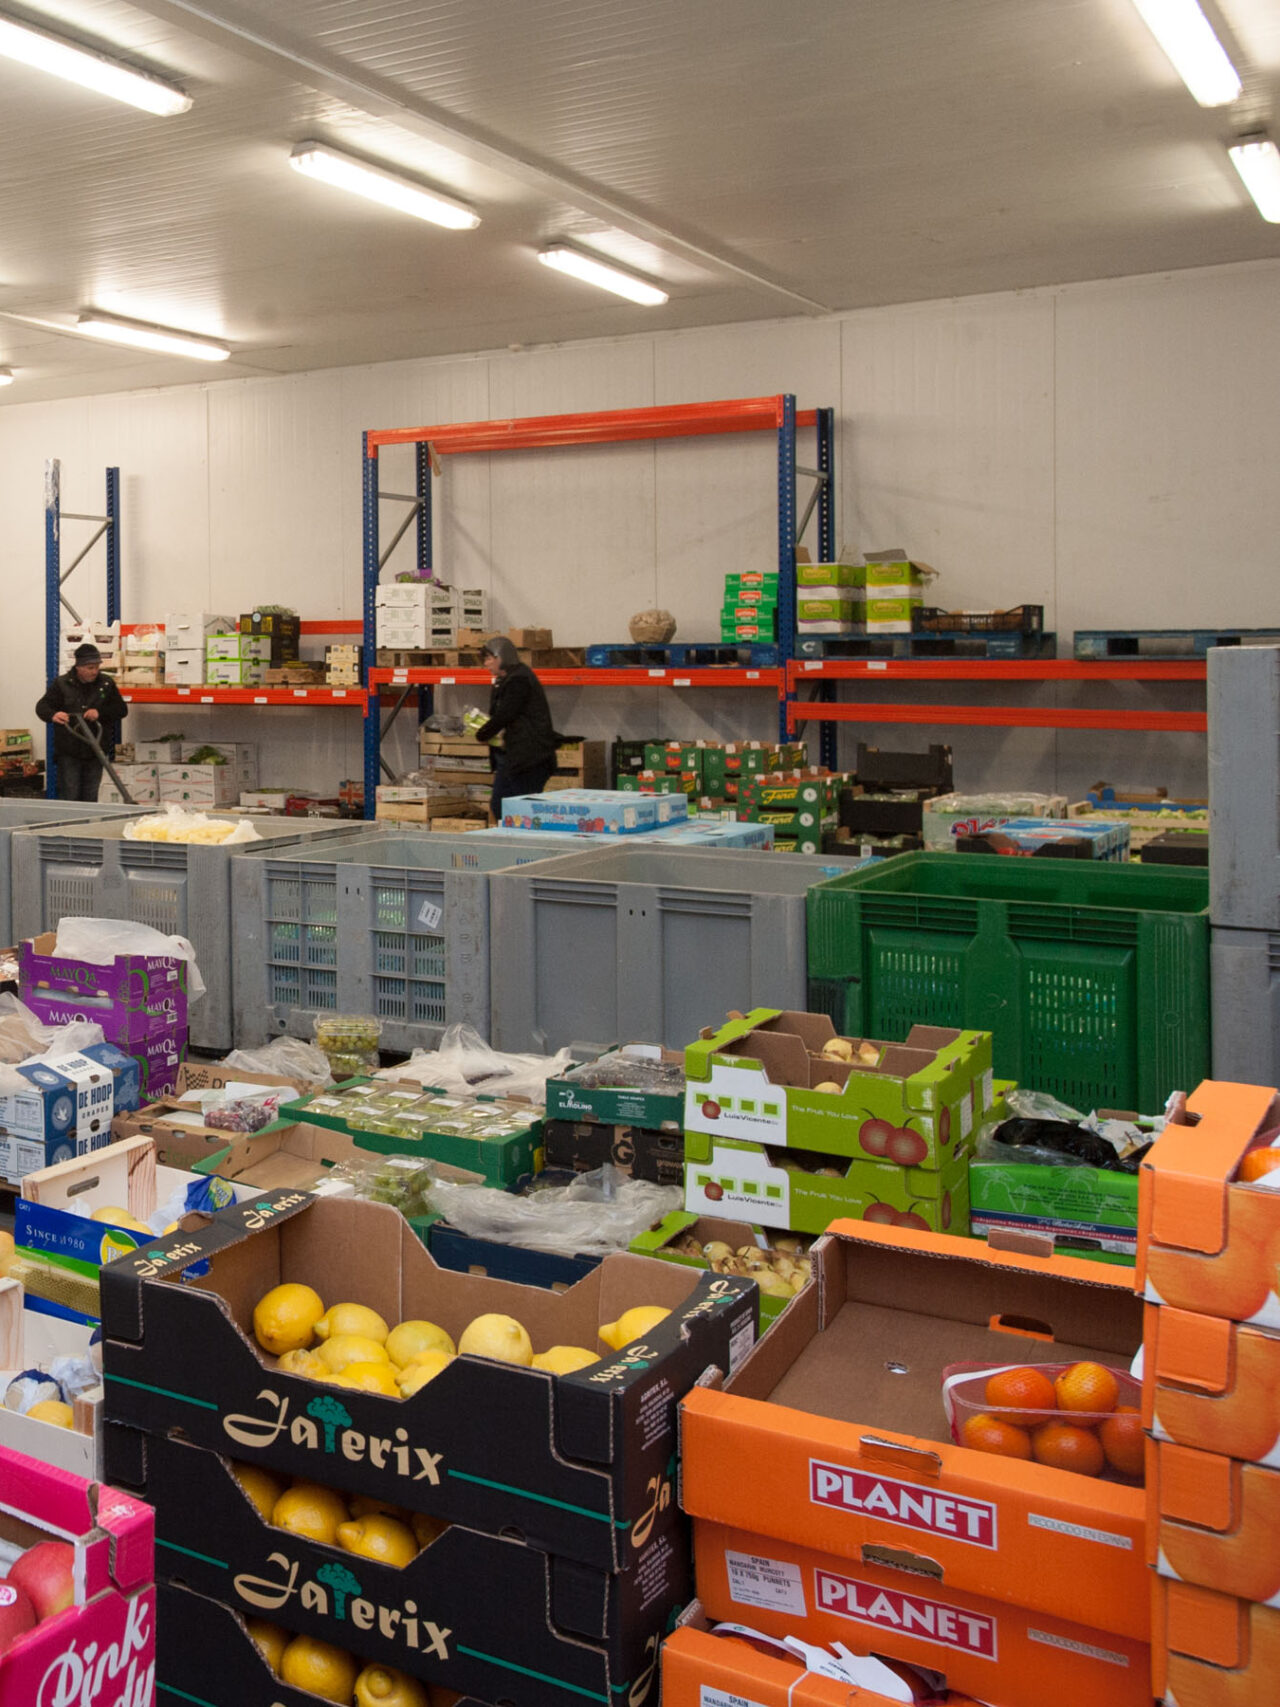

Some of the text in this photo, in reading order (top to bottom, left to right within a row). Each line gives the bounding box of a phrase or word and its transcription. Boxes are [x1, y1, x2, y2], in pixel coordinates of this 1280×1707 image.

[78, 1083, 113, 1109] DE HOOP
[81, 1104, 110, 1120] GRAPES
[78, 1139, 88, 1156] DE
[25, 1224, 86, 1251] SINCE 1980
[816, 1467, 990, 1539] PLANET
[1029, 1513, 1083, 1538] PRODUCIDO
[751, 1556, 770, 1567] SPAIN
[762, 1575, 791, 1588] PUNNETS
[821, 1575, 990, 1649] PLANET
[35, 1595, 151, 1707] Pink
[728, 1695, 749, 1707] SPAIN
